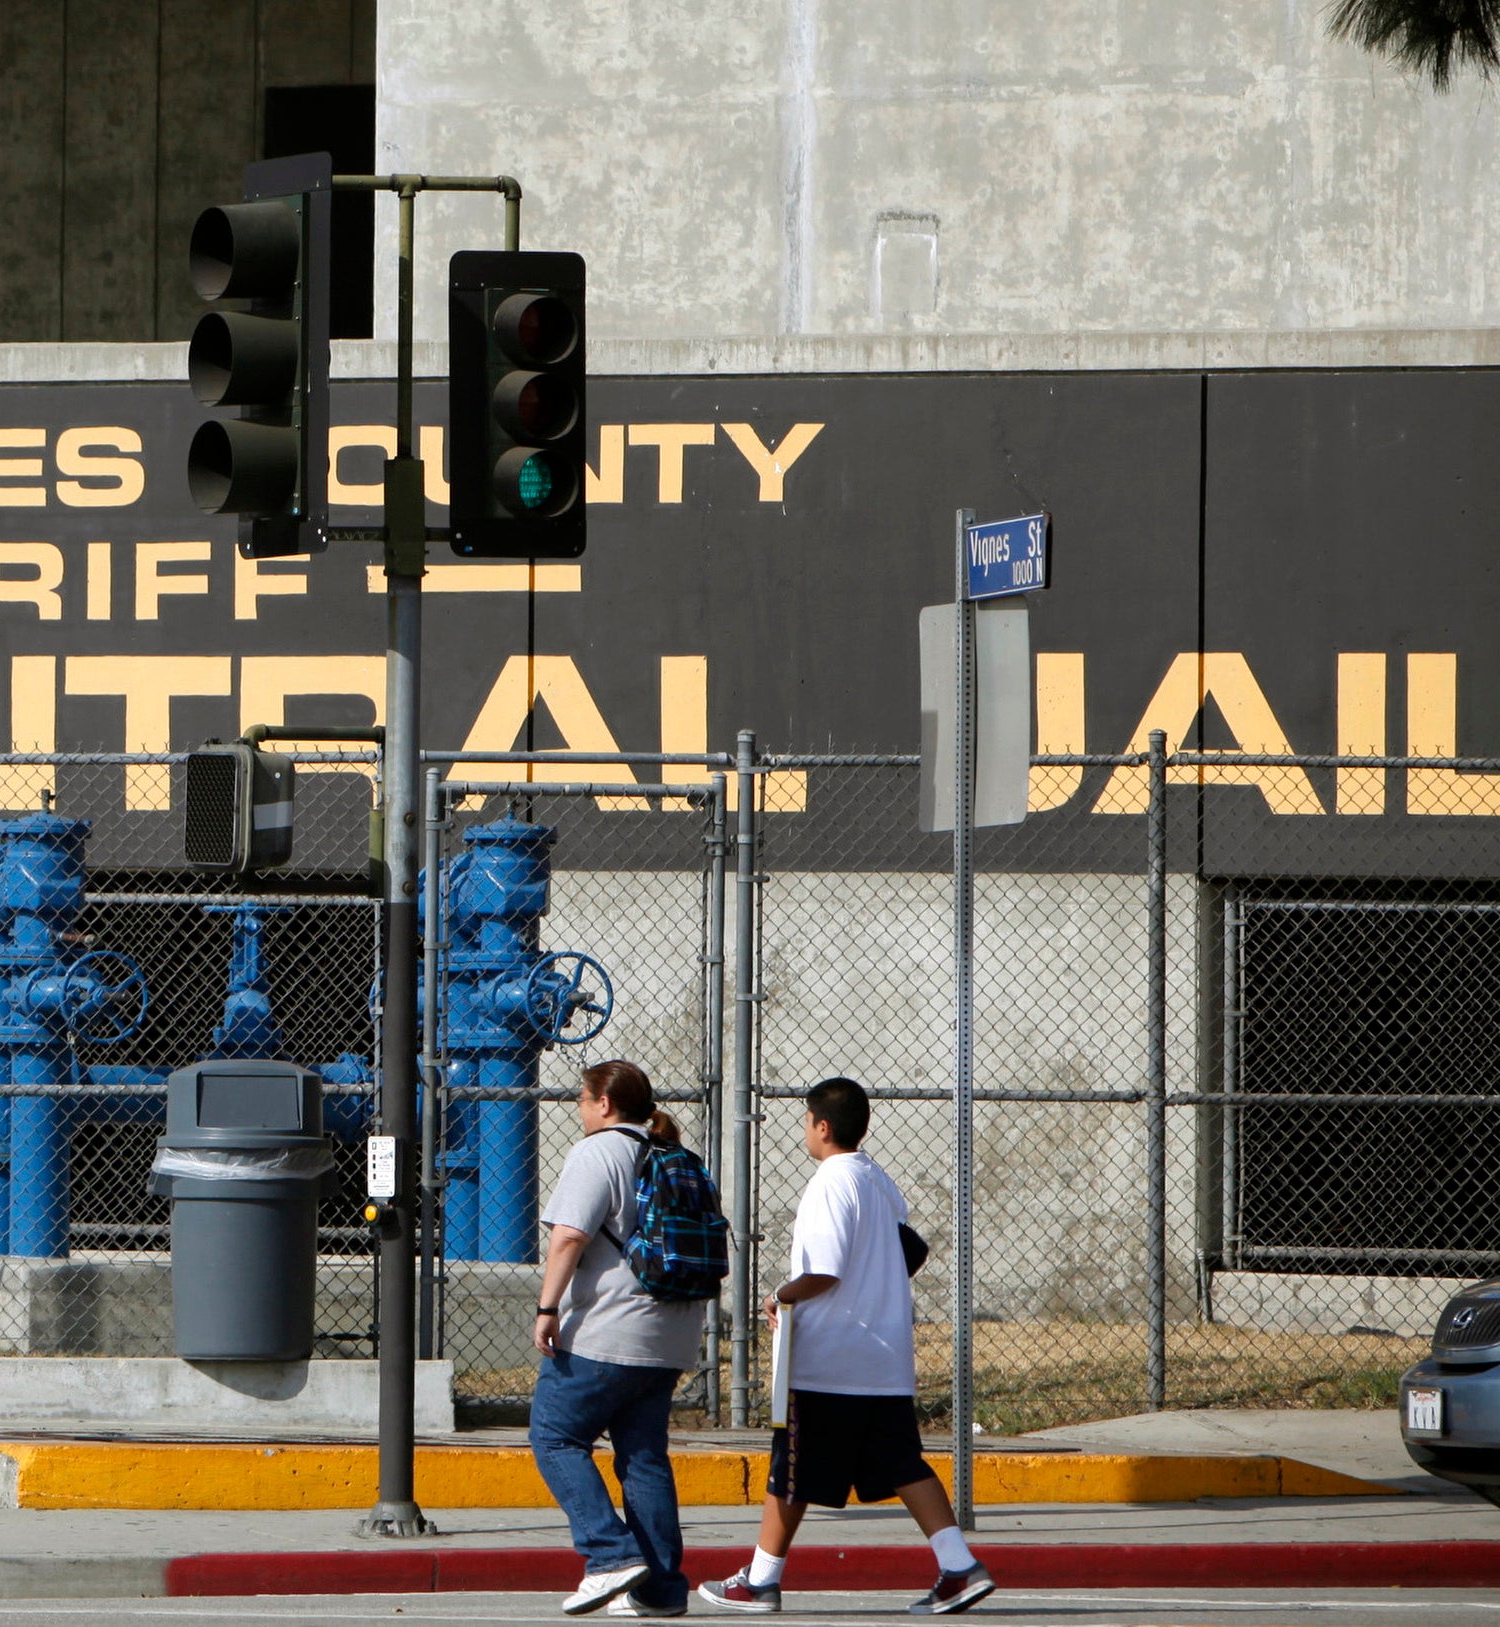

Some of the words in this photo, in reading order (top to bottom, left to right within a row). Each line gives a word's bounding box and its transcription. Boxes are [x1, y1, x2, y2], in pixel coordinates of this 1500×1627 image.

[328, 423, 825, 507] OTY
[969, 530, 1011, 577] Vignes
[1027, 520, 1043, 558] St
[1012, 558, 1033, 586] 1000
[1036, 556, 1043, 582] N
[1027, 652, 1500, 816] JAIL
